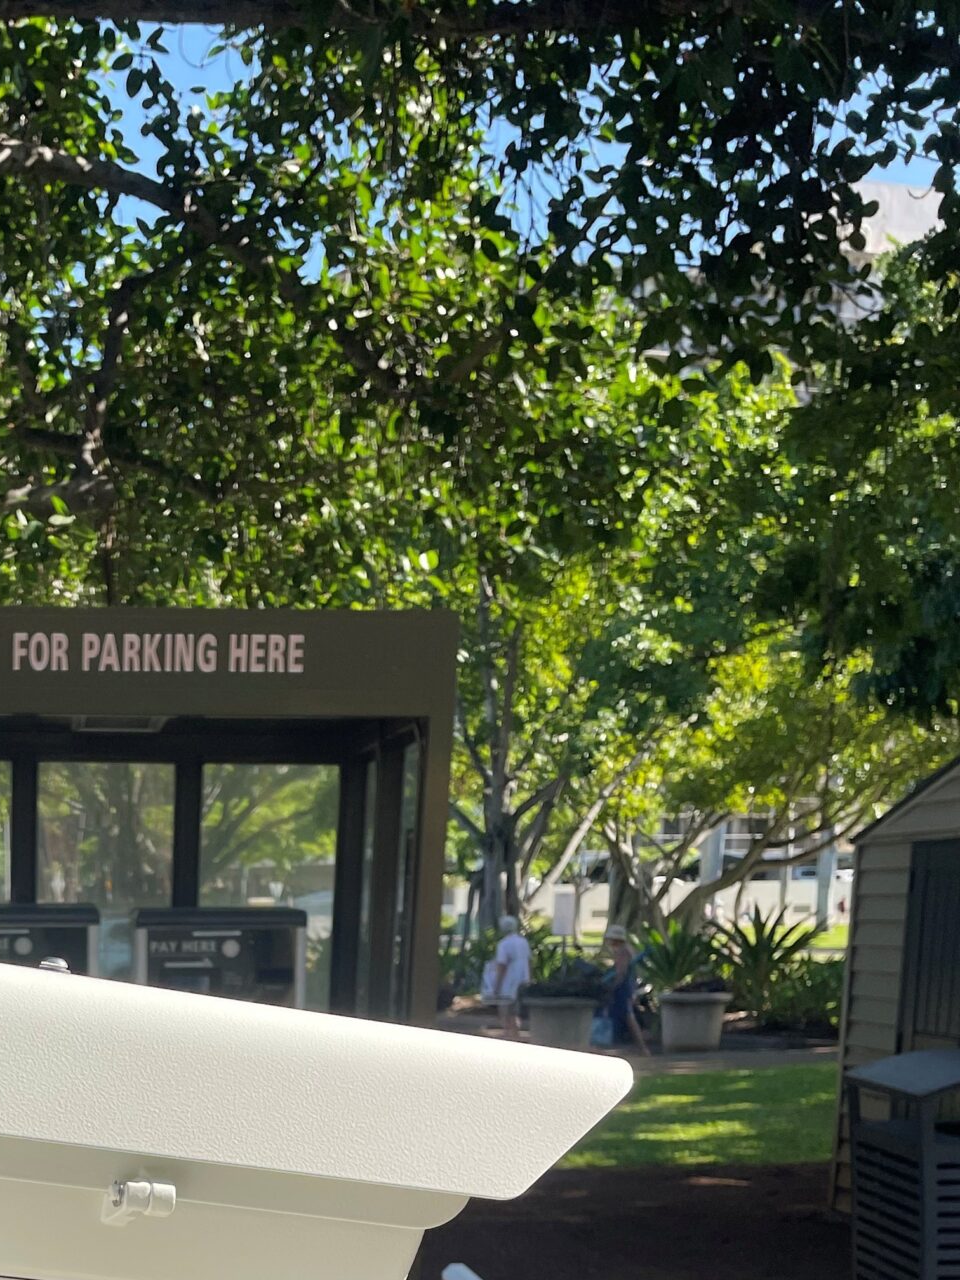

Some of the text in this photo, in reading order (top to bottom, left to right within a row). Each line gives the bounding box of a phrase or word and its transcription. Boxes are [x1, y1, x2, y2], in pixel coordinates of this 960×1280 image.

[11, 631, 69, 671] FOR
[81, 632, 218, 673] PARKING
[228, 633, 305, 673] HERE
[150, 940, 178, 953] PAY
